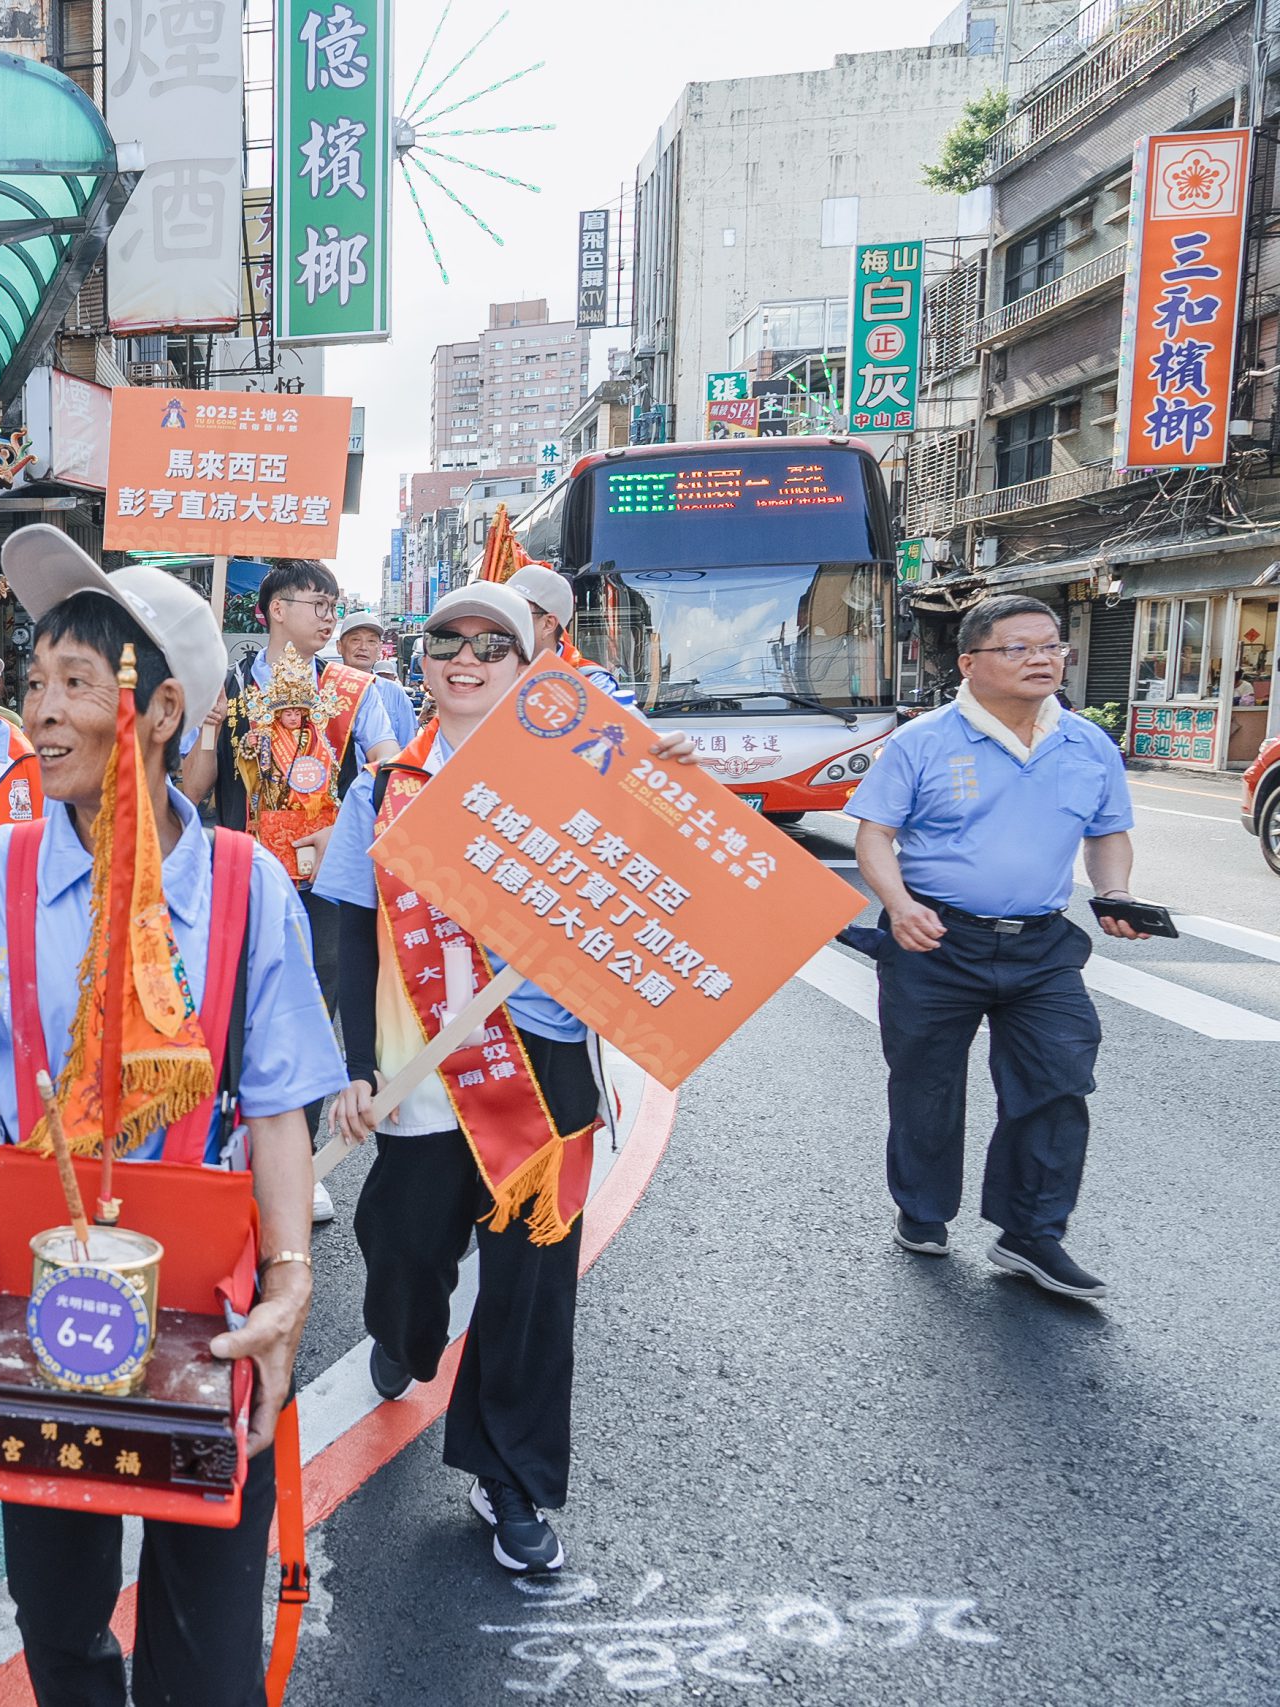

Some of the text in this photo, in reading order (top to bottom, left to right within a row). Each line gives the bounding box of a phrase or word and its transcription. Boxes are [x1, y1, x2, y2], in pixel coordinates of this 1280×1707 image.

[295, 4, 370, 307] 億檳榔
[582, 212, 605, 287] 眉飛色舞
[860, 246, 918, 275] 梅山
[580, 290, 604, 306] KTV
[1144, 232, 1221, 454] 三和檳榔
[728, 402, 755, 420] SPA
[853, 410, 912, 428] 中山店
[165, 449, 288, 483] 馬來西亞
[527, 692, 567, 729] 6-12
[1135, 707, 1214, 732] 三和檳榔
[742, 735, 780, 752] 客運
[1135, 734, 1212, 760] 歡迎光臨
[296, 773, 316, 783] 5-3
[624, 773, 640, 789] TU
[560, 808, 693, 917] 馬來西亞
[460, 780, 734, 1001] 檳城關打賀丁加奴律
[463, 834, 677, 1008] 福德祠大伯公廟
[57, 1317, 114, 1354] 6-4
